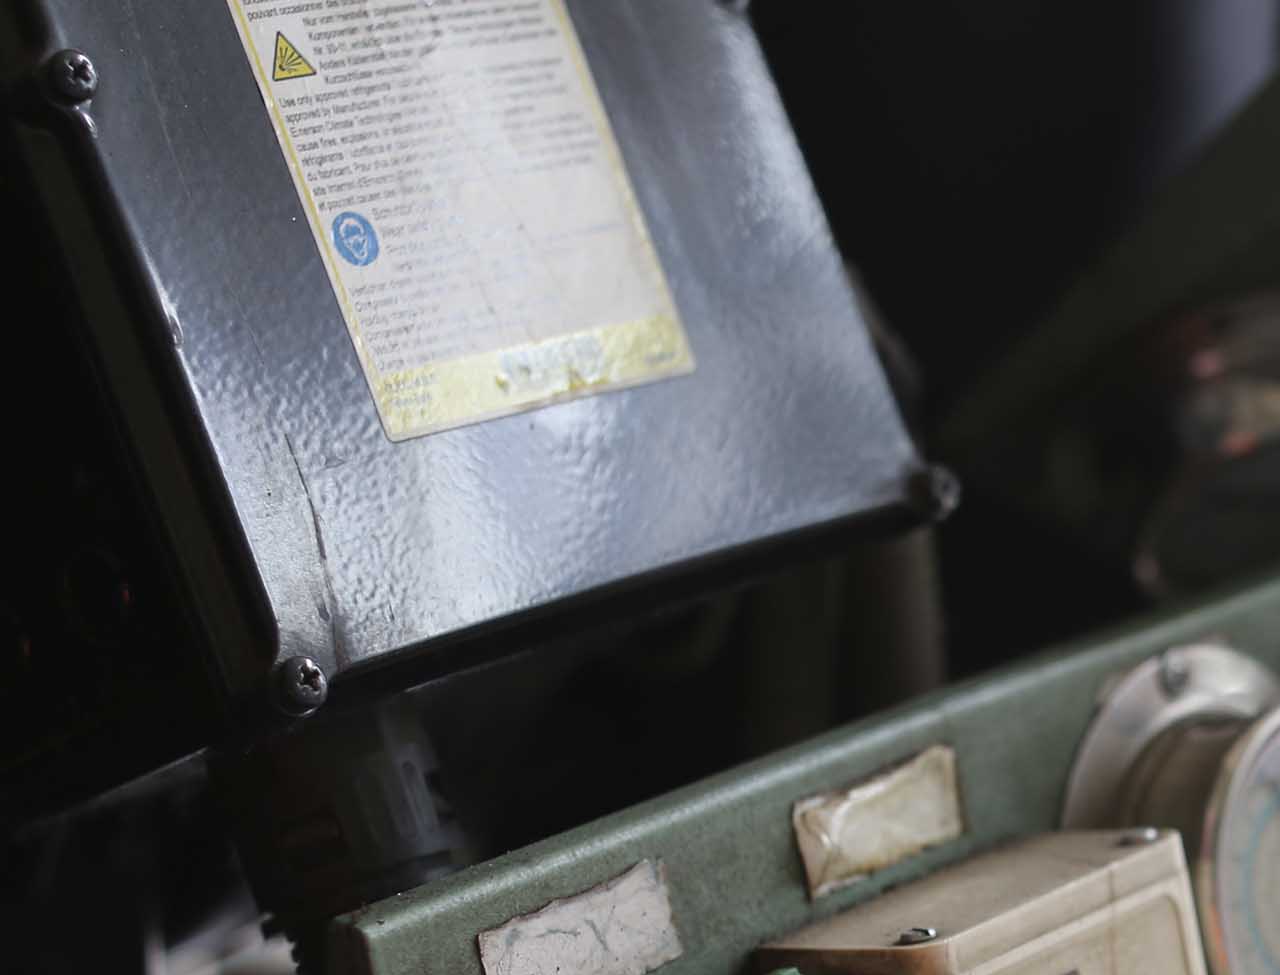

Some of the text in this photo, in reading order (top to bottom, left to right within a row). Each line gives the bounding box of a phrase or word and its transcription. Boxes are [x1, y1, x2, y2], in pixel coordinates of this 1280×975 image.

[279, 97, 296, 108] Use
[296, 95, 313, 107] only
[315, 89, 349, 103] approved
[285, 107, 320, 124] approved
